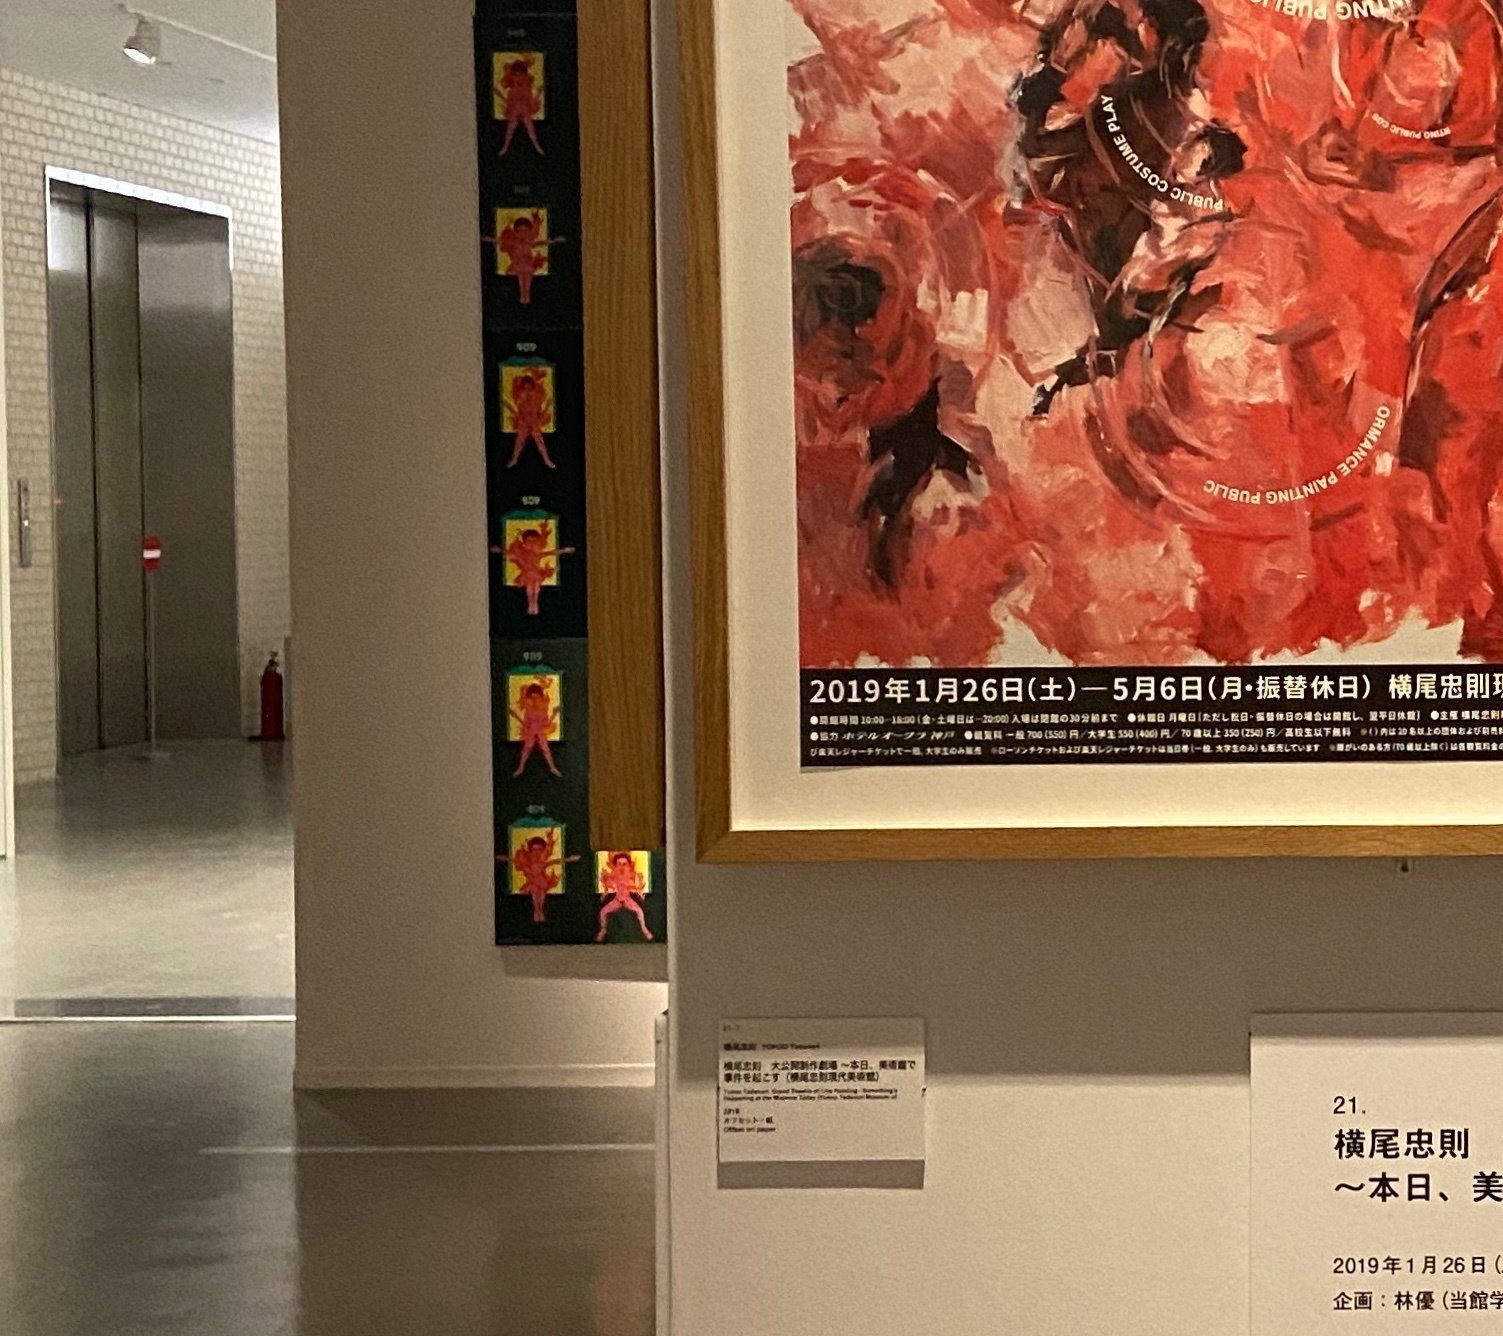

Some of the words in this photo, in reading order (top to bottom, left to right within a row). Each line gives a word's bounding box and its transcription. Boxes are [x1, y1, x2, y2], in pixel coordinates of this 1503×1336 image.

[1100, 94, 1121, 133] PLAY
[1113, 133, 1169, 193] COSTUME
[1170, 186, 1224, 213] PUBLIC
[1336, 405, 1391, 477] ORMANCE
[1203, 479, 1261, 506] PUBLIC
[1265, 475, 1339, 506] PAINTING
[1333, 1095, 1367, 1115] 21.
[1333, 1127, 1470, 1160] 横尾忠則
